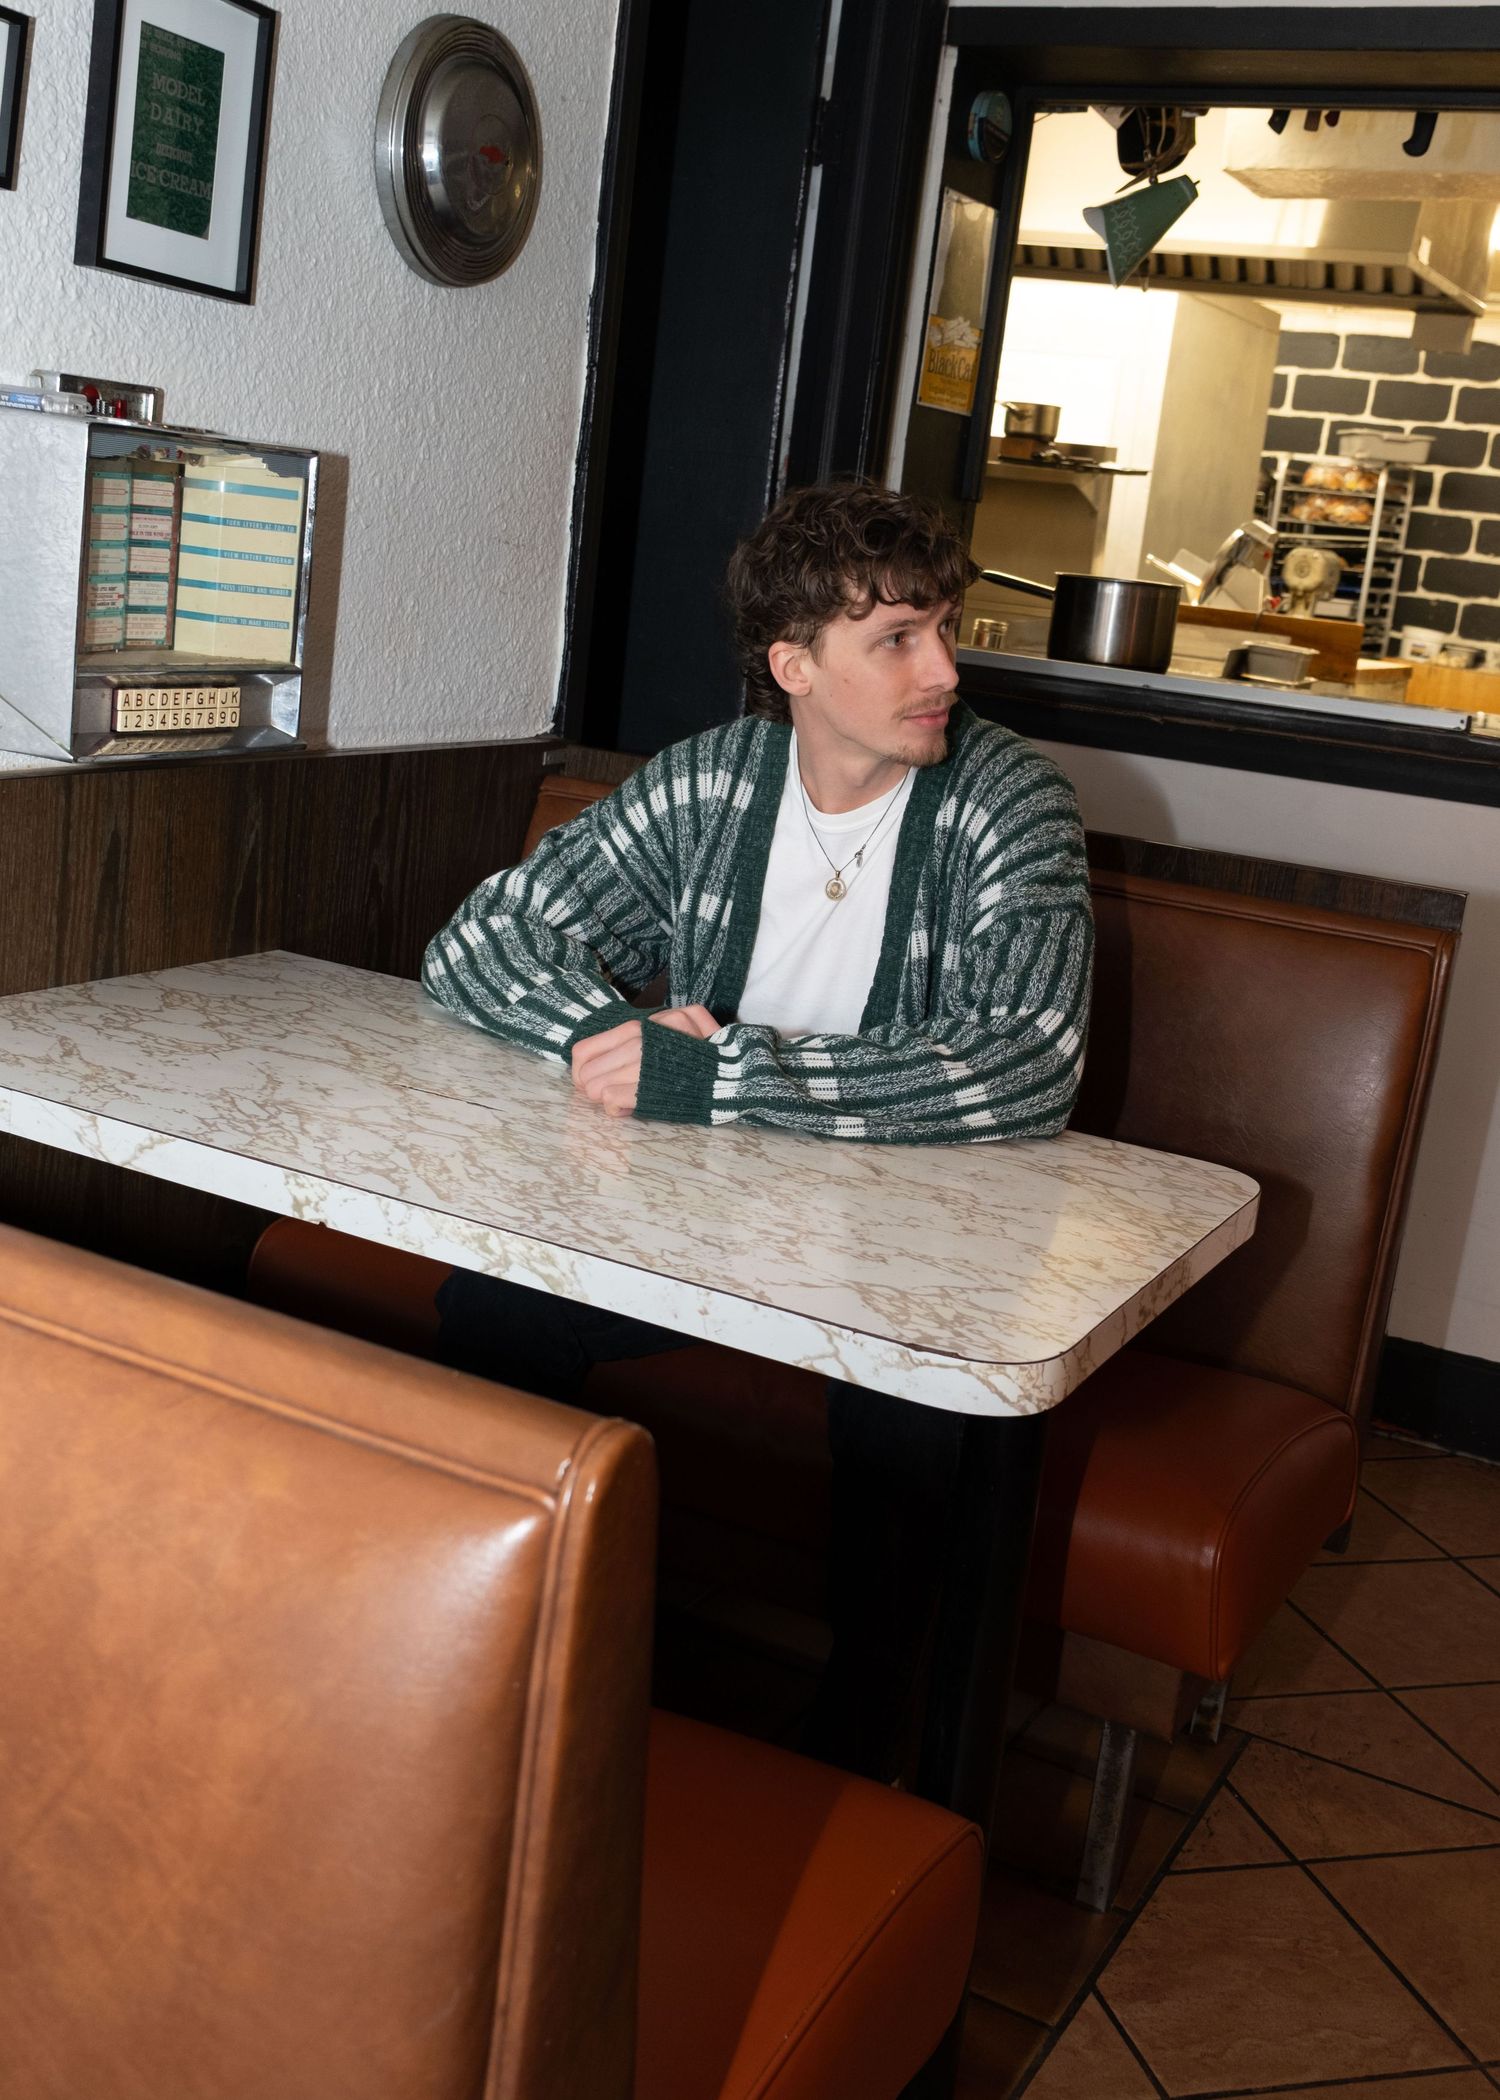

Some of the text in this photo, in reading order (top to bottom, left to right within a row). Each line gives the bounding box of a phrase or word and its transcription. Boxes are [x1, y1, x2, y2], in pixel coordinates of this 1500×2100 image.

[152, 72, 207, 107] MODEL
[150, 102, 204, 135] DAIRY
[131, 160, 213, 201] ICE CREAM
[927, 348, 957, 379] Black
[223, 551, 239, 559] VIEW
[264, 555, 293, 565] PROGRAM
[220, 583, 236, 591] PRESS
[256, 586, 268, 594] AND
[263, 620, 289, 629] SELECTION
